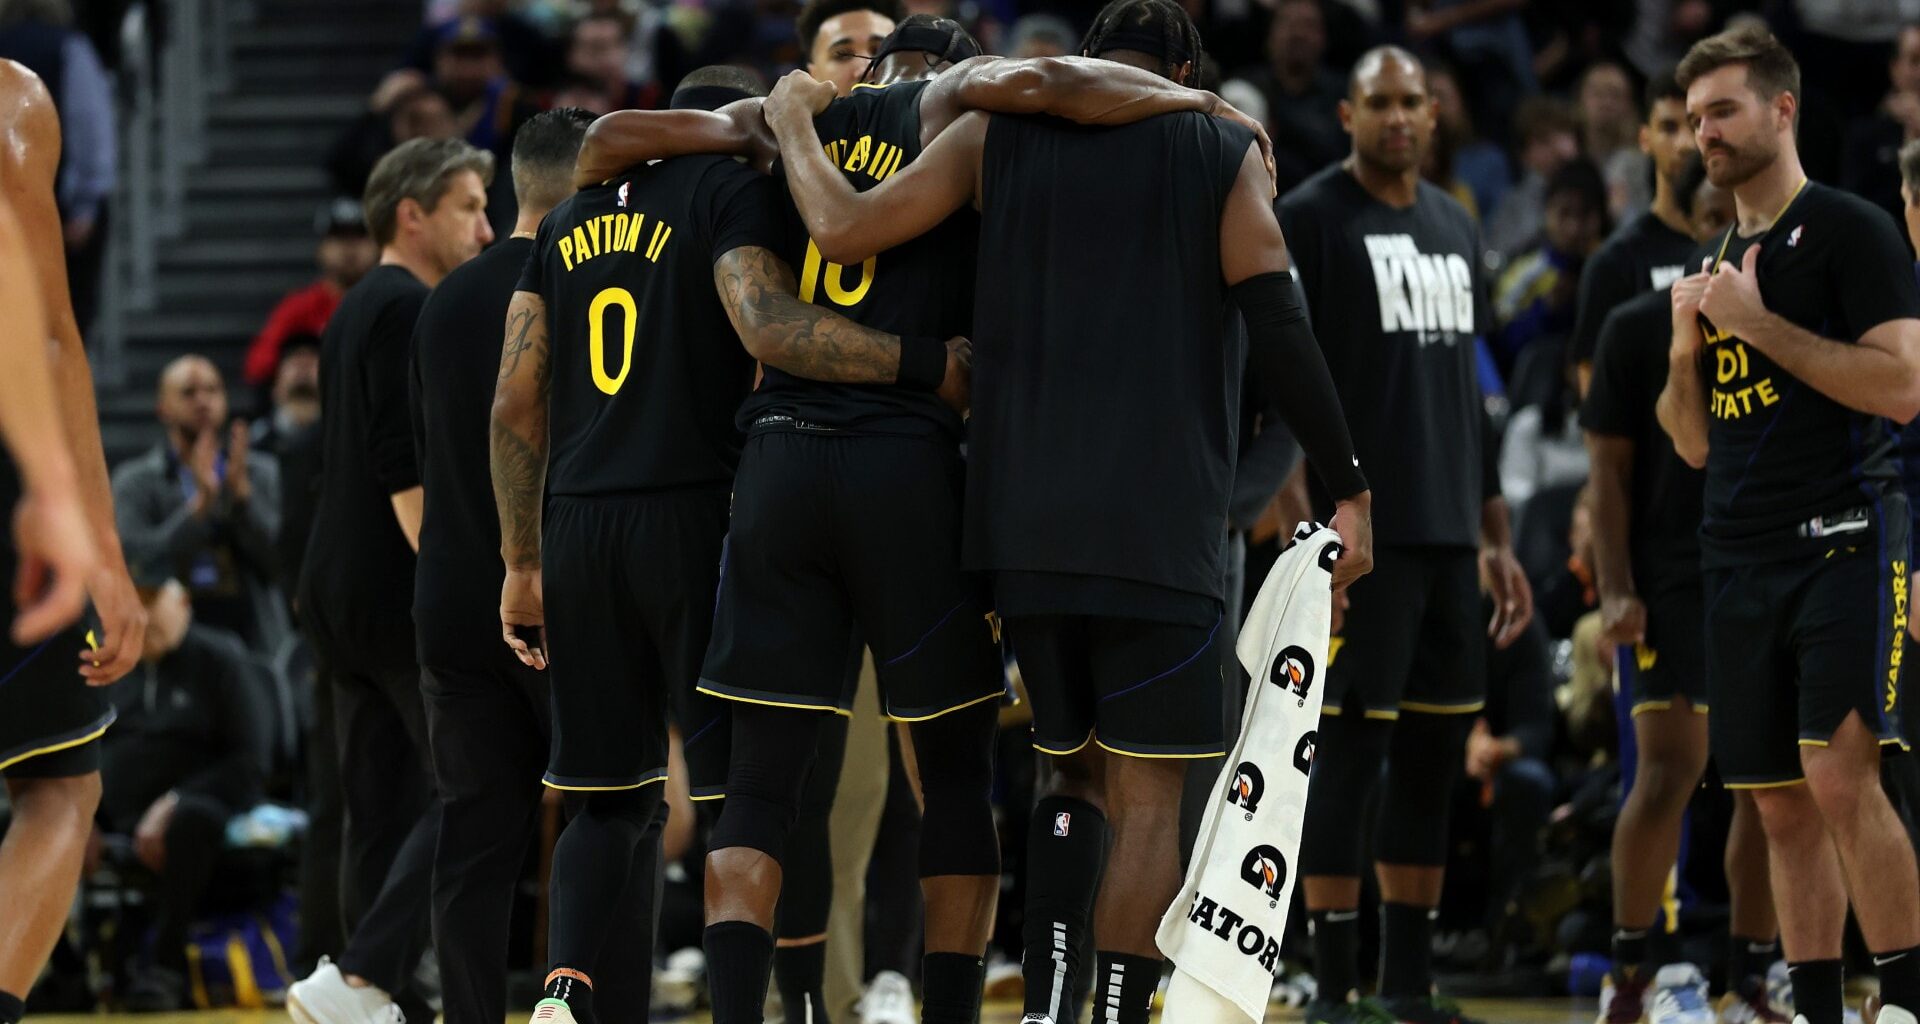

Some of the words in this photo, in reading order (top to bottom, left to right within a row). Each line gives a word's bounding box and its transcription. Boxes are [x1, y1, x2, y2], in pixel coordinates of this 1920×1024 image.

[866, 141, 903, 181] III
[558, 213, 645, 271] PAYTON
[645, 221, 672, 263] II
[1371, 253, 1475, 333] KING
[588, 287, 637, 396] 0
[1884, 561, 1908, 712] WARRIORS
[1187, 891, 1279, 976] ATOR
